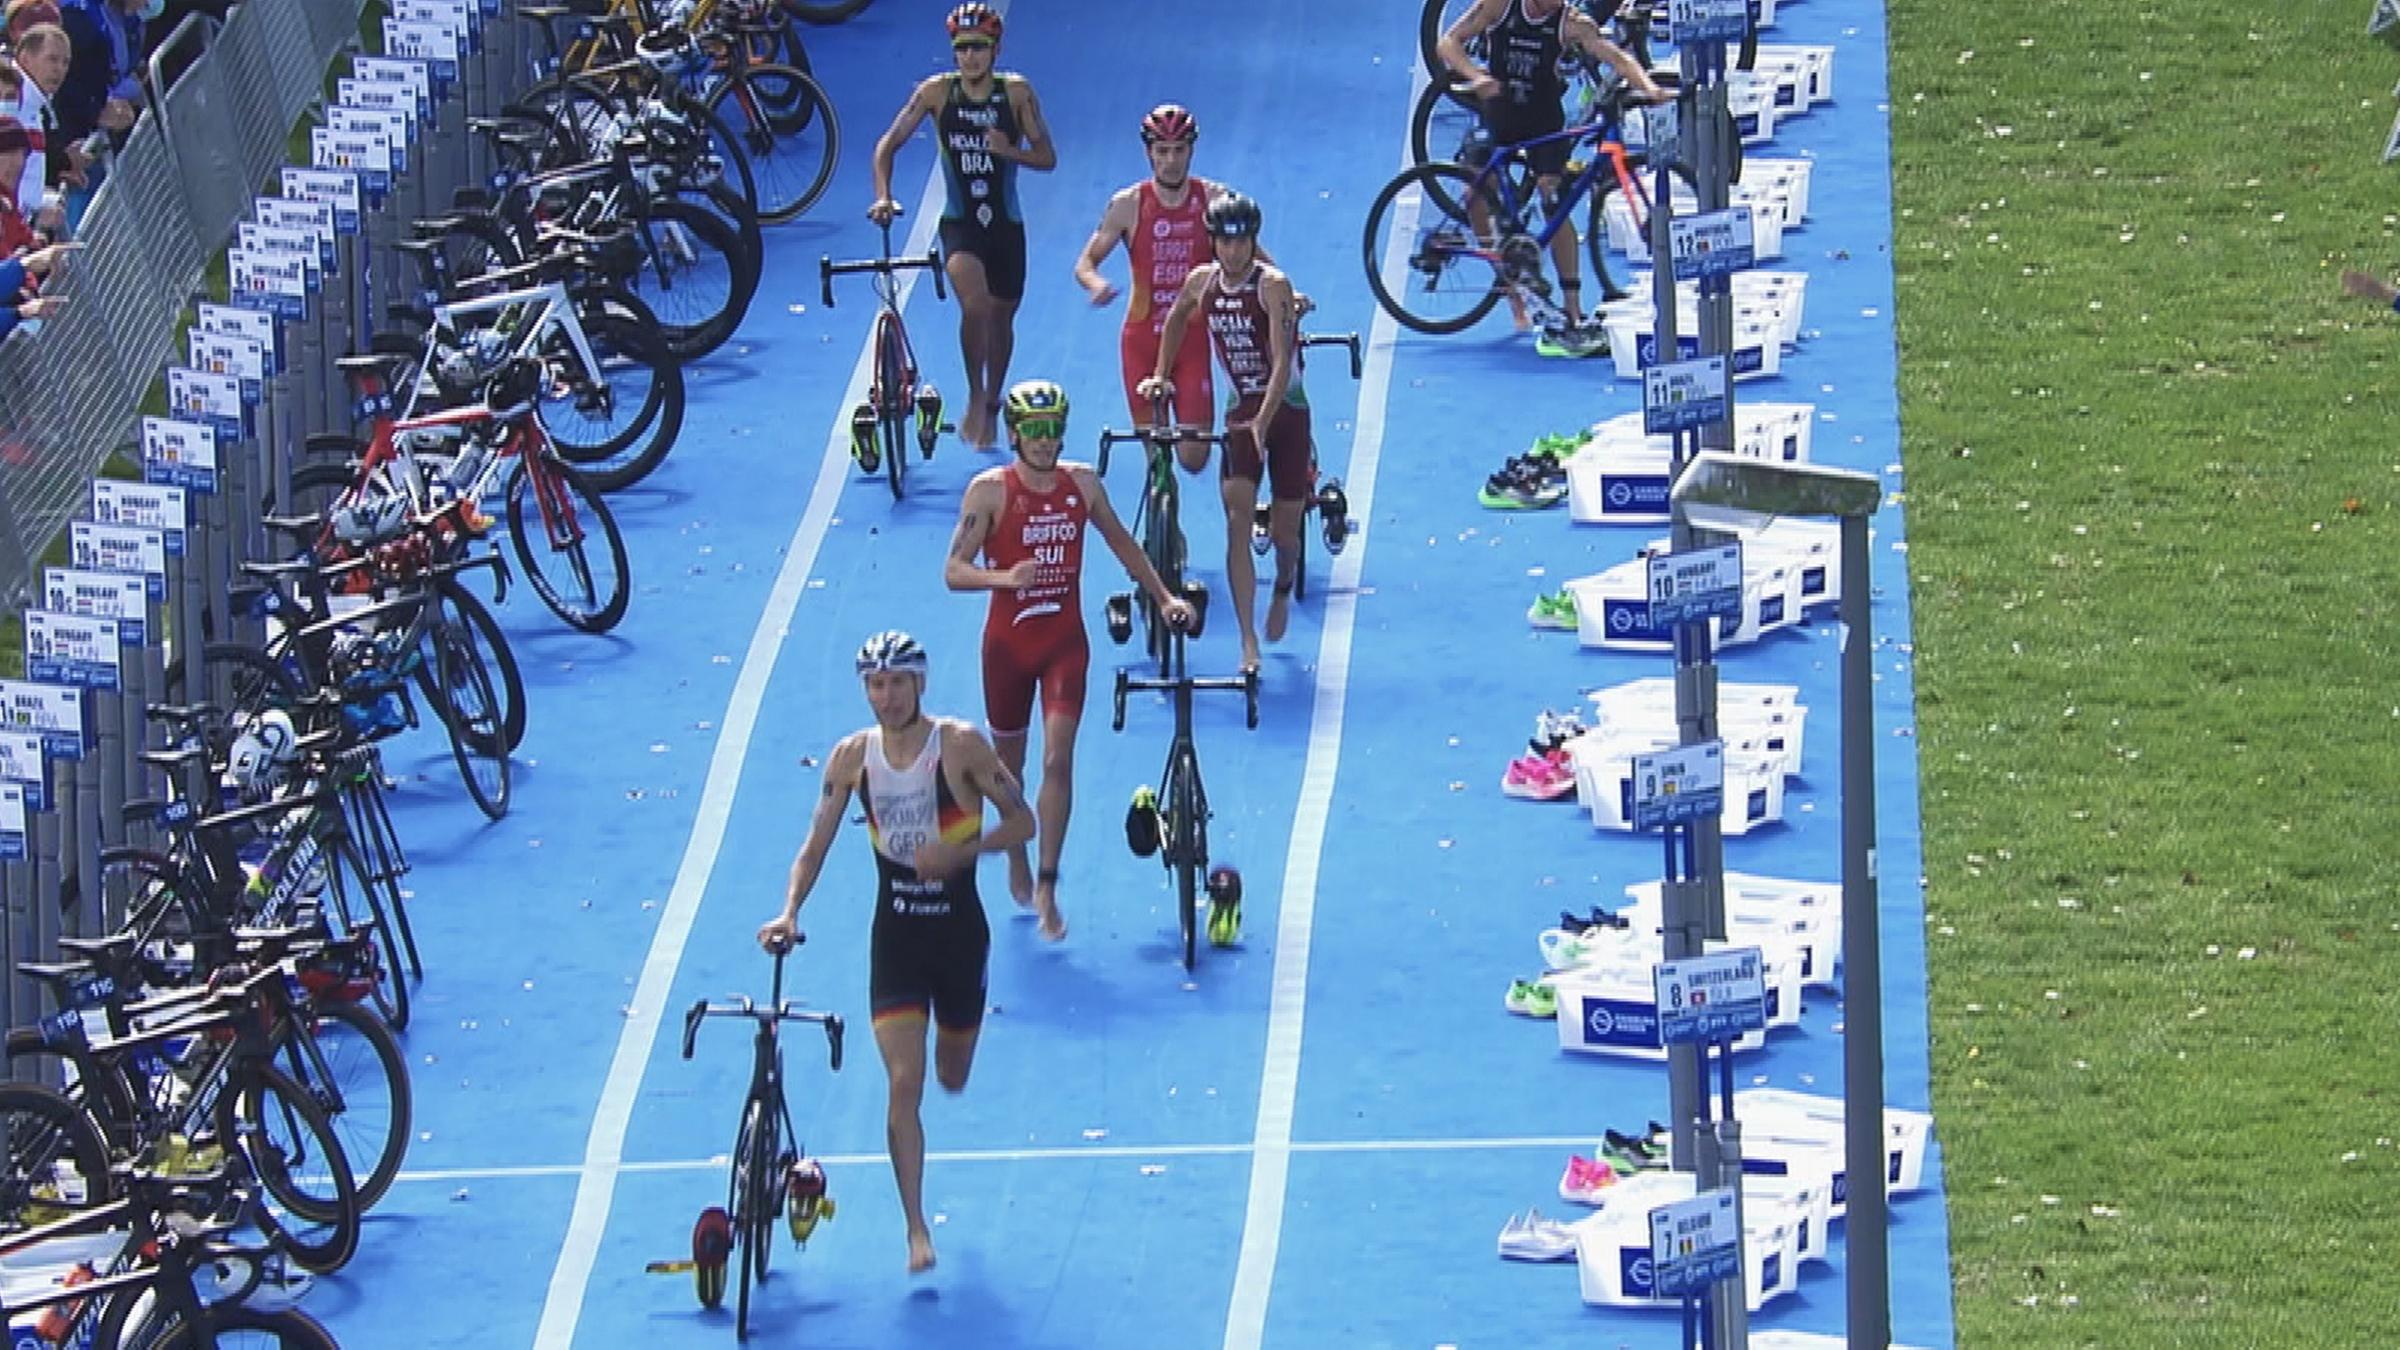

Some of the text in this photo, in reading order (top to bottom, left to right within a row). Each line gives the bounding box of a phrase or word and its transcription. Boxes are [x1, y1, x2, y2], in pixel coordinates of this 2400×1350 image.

[961, 153, 994, 174] BRA
[1034, 546, 1065, 565] SUI
[1655, 575, 1673, 598] 10
[1646, 774, 1656, 797] 9
[1670, 983, 1682, 1008] 8
